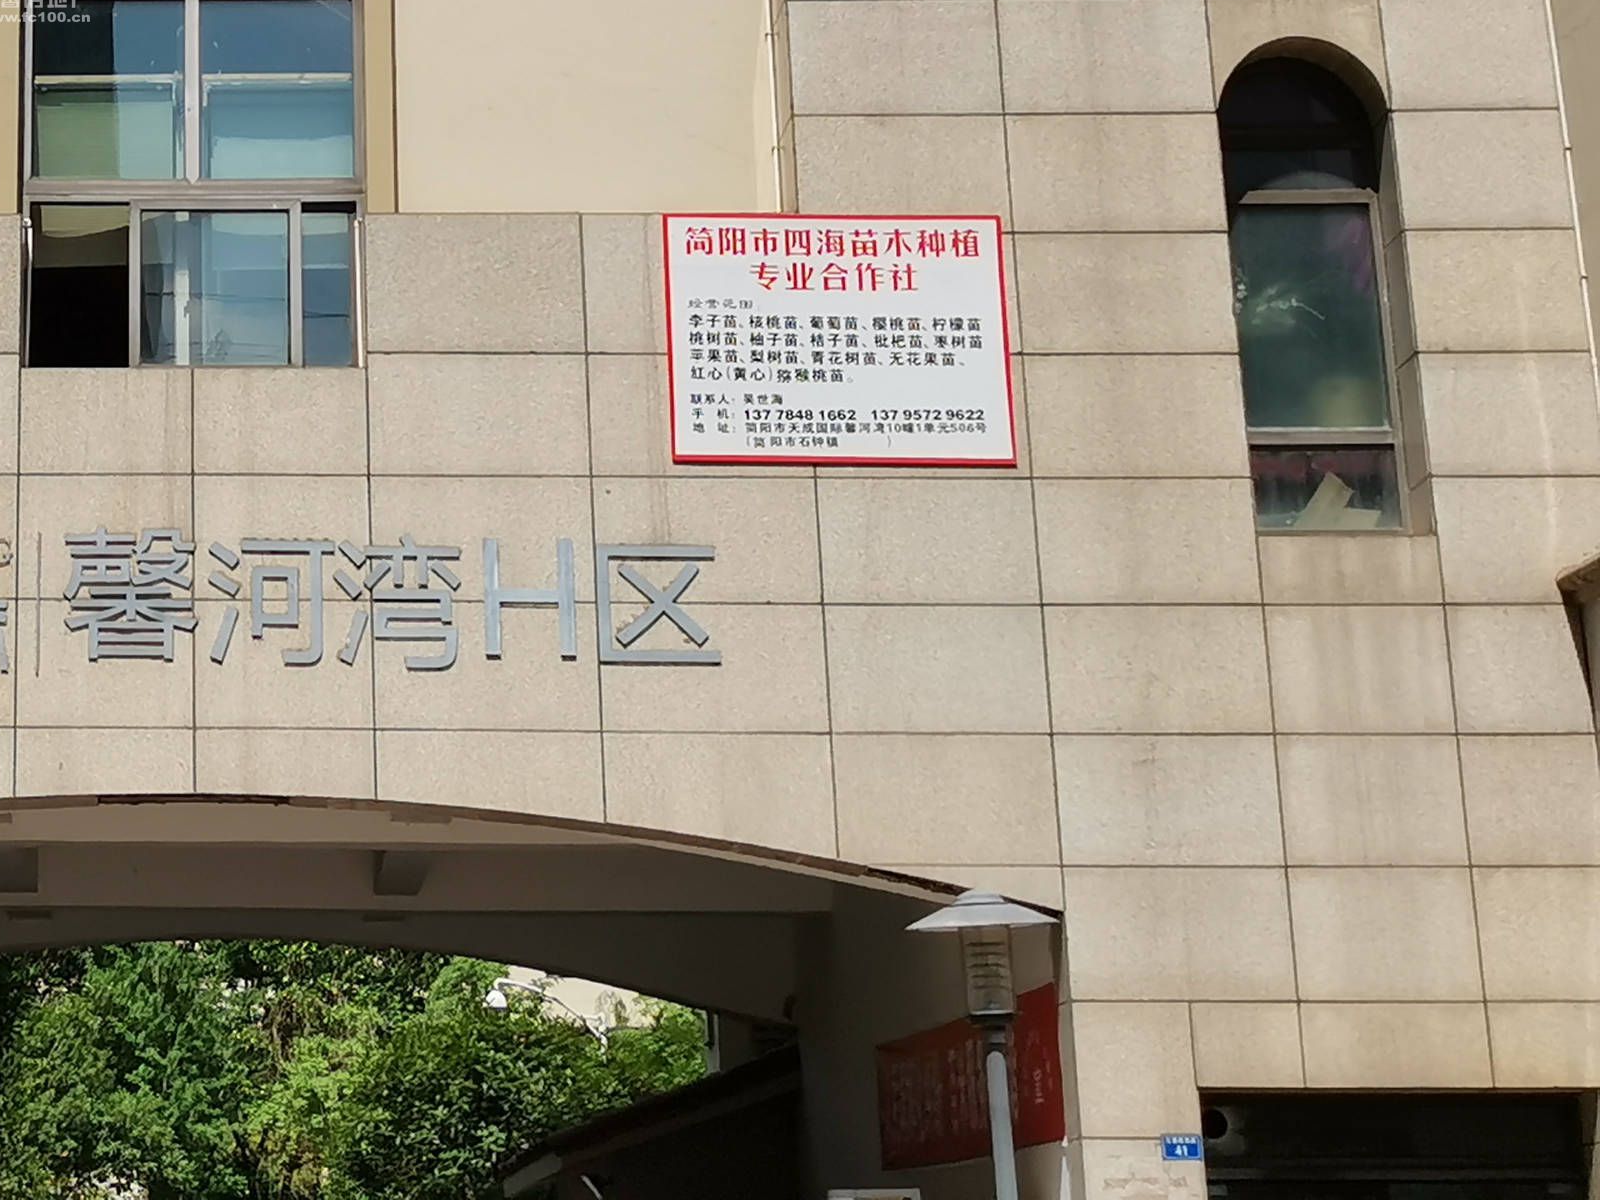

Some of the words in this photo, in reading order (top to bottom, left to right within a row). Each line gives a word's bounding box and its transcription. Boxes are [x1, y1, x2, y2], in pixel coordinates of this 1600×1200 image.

[685, 226, 980, 258] 简阳市四海苗木种植
[751, 262, 918, 291] 专业合作社
[744, 409, 771, 421] 137
[777, 409, 814, 421] 7848
[819, 409, 857, 421] 1662
[871, 409, 898, 421] 137
[903, 409, 942, 421] 9572
[946, 409, 985, 421] 9622
[63, 525, 723, 671] 馨河湾H区
